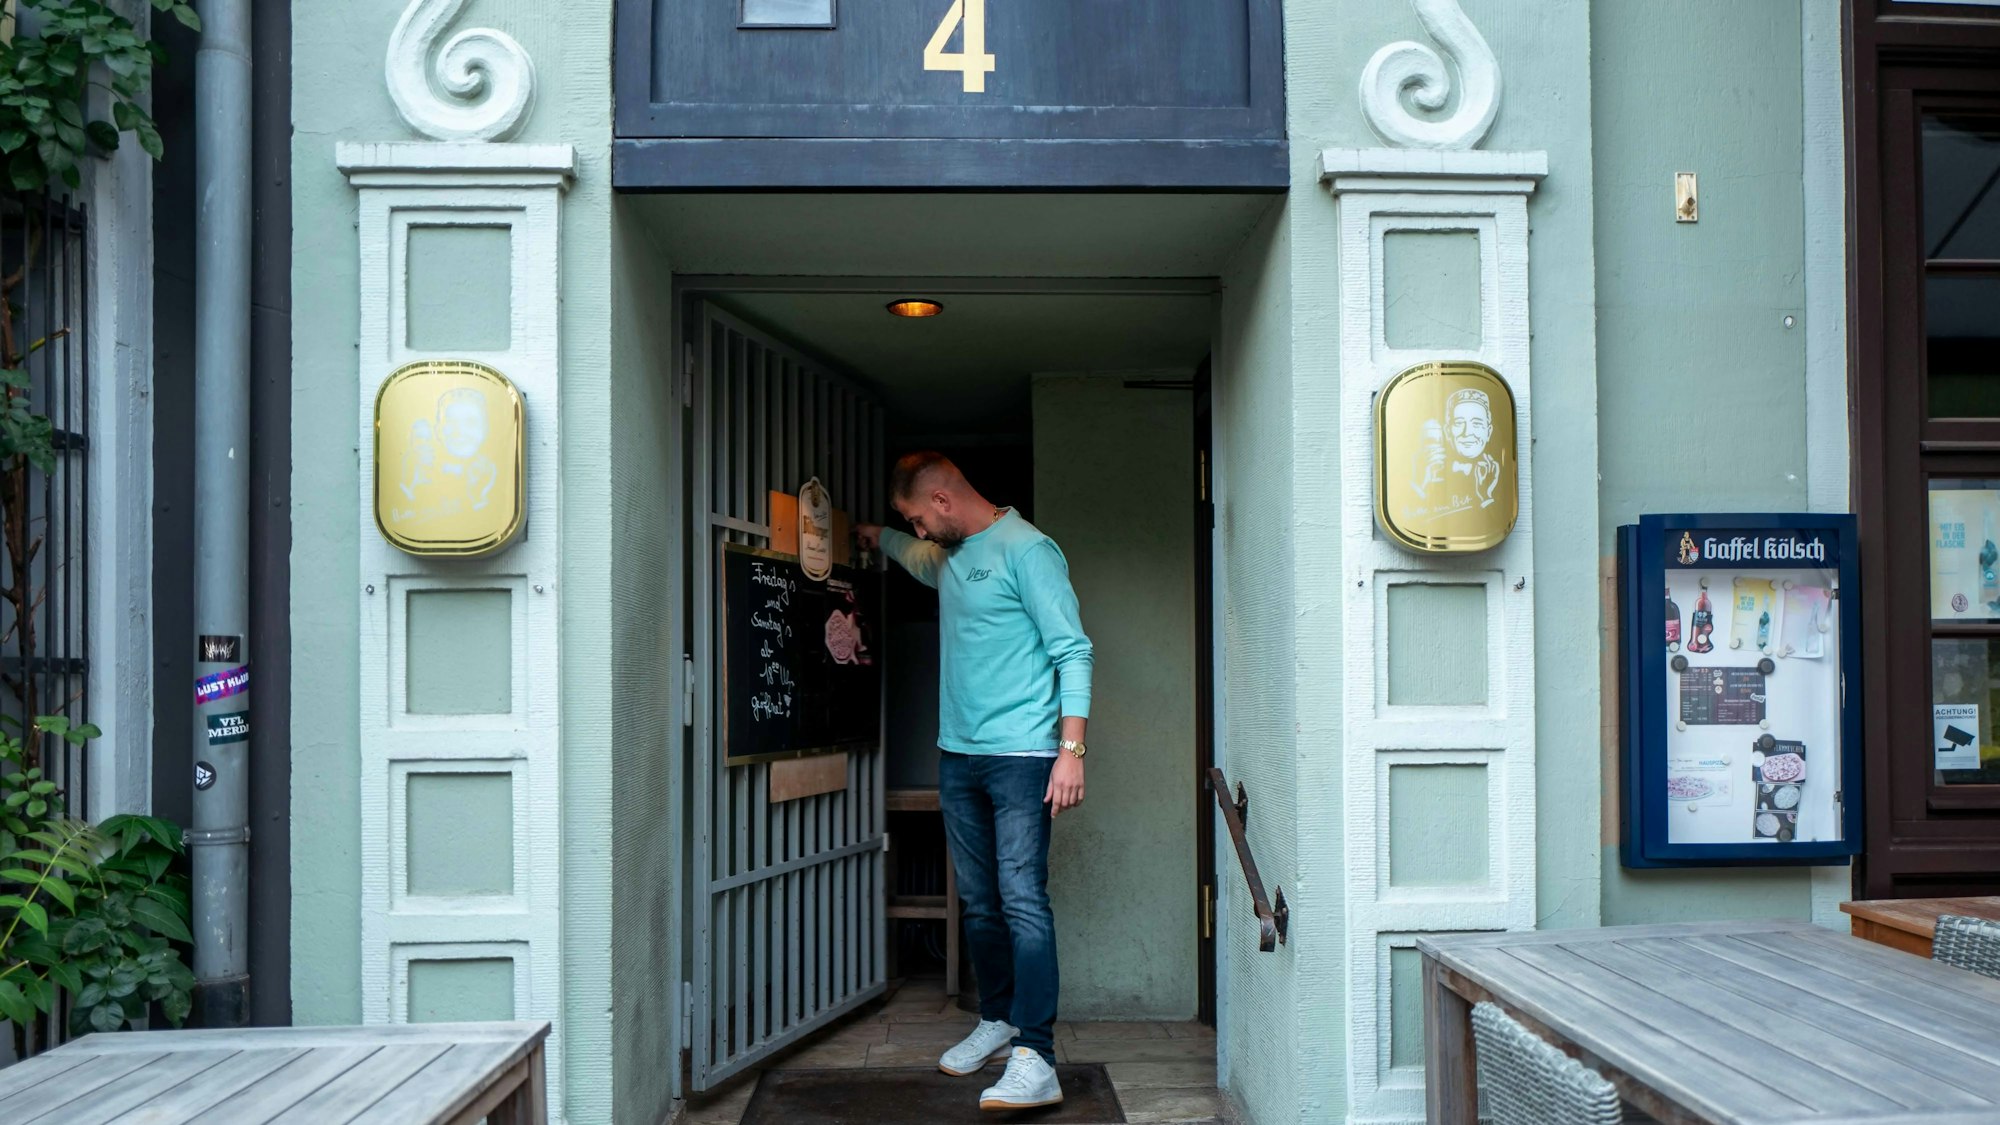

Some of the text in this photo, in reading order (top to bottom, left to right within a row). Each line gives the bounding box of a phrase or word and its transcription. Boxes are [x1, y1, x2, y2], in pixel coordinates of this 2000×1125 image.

[924, 0, 995, 93] 4
[1704, 537, 1825, 562] Gaffel Kölsch
[764, 594, 783, 613] und
[760, 639, 775, 658] ab
[197, 680, 225, 696] LUST
[219, 716, 244, 727] VFL
